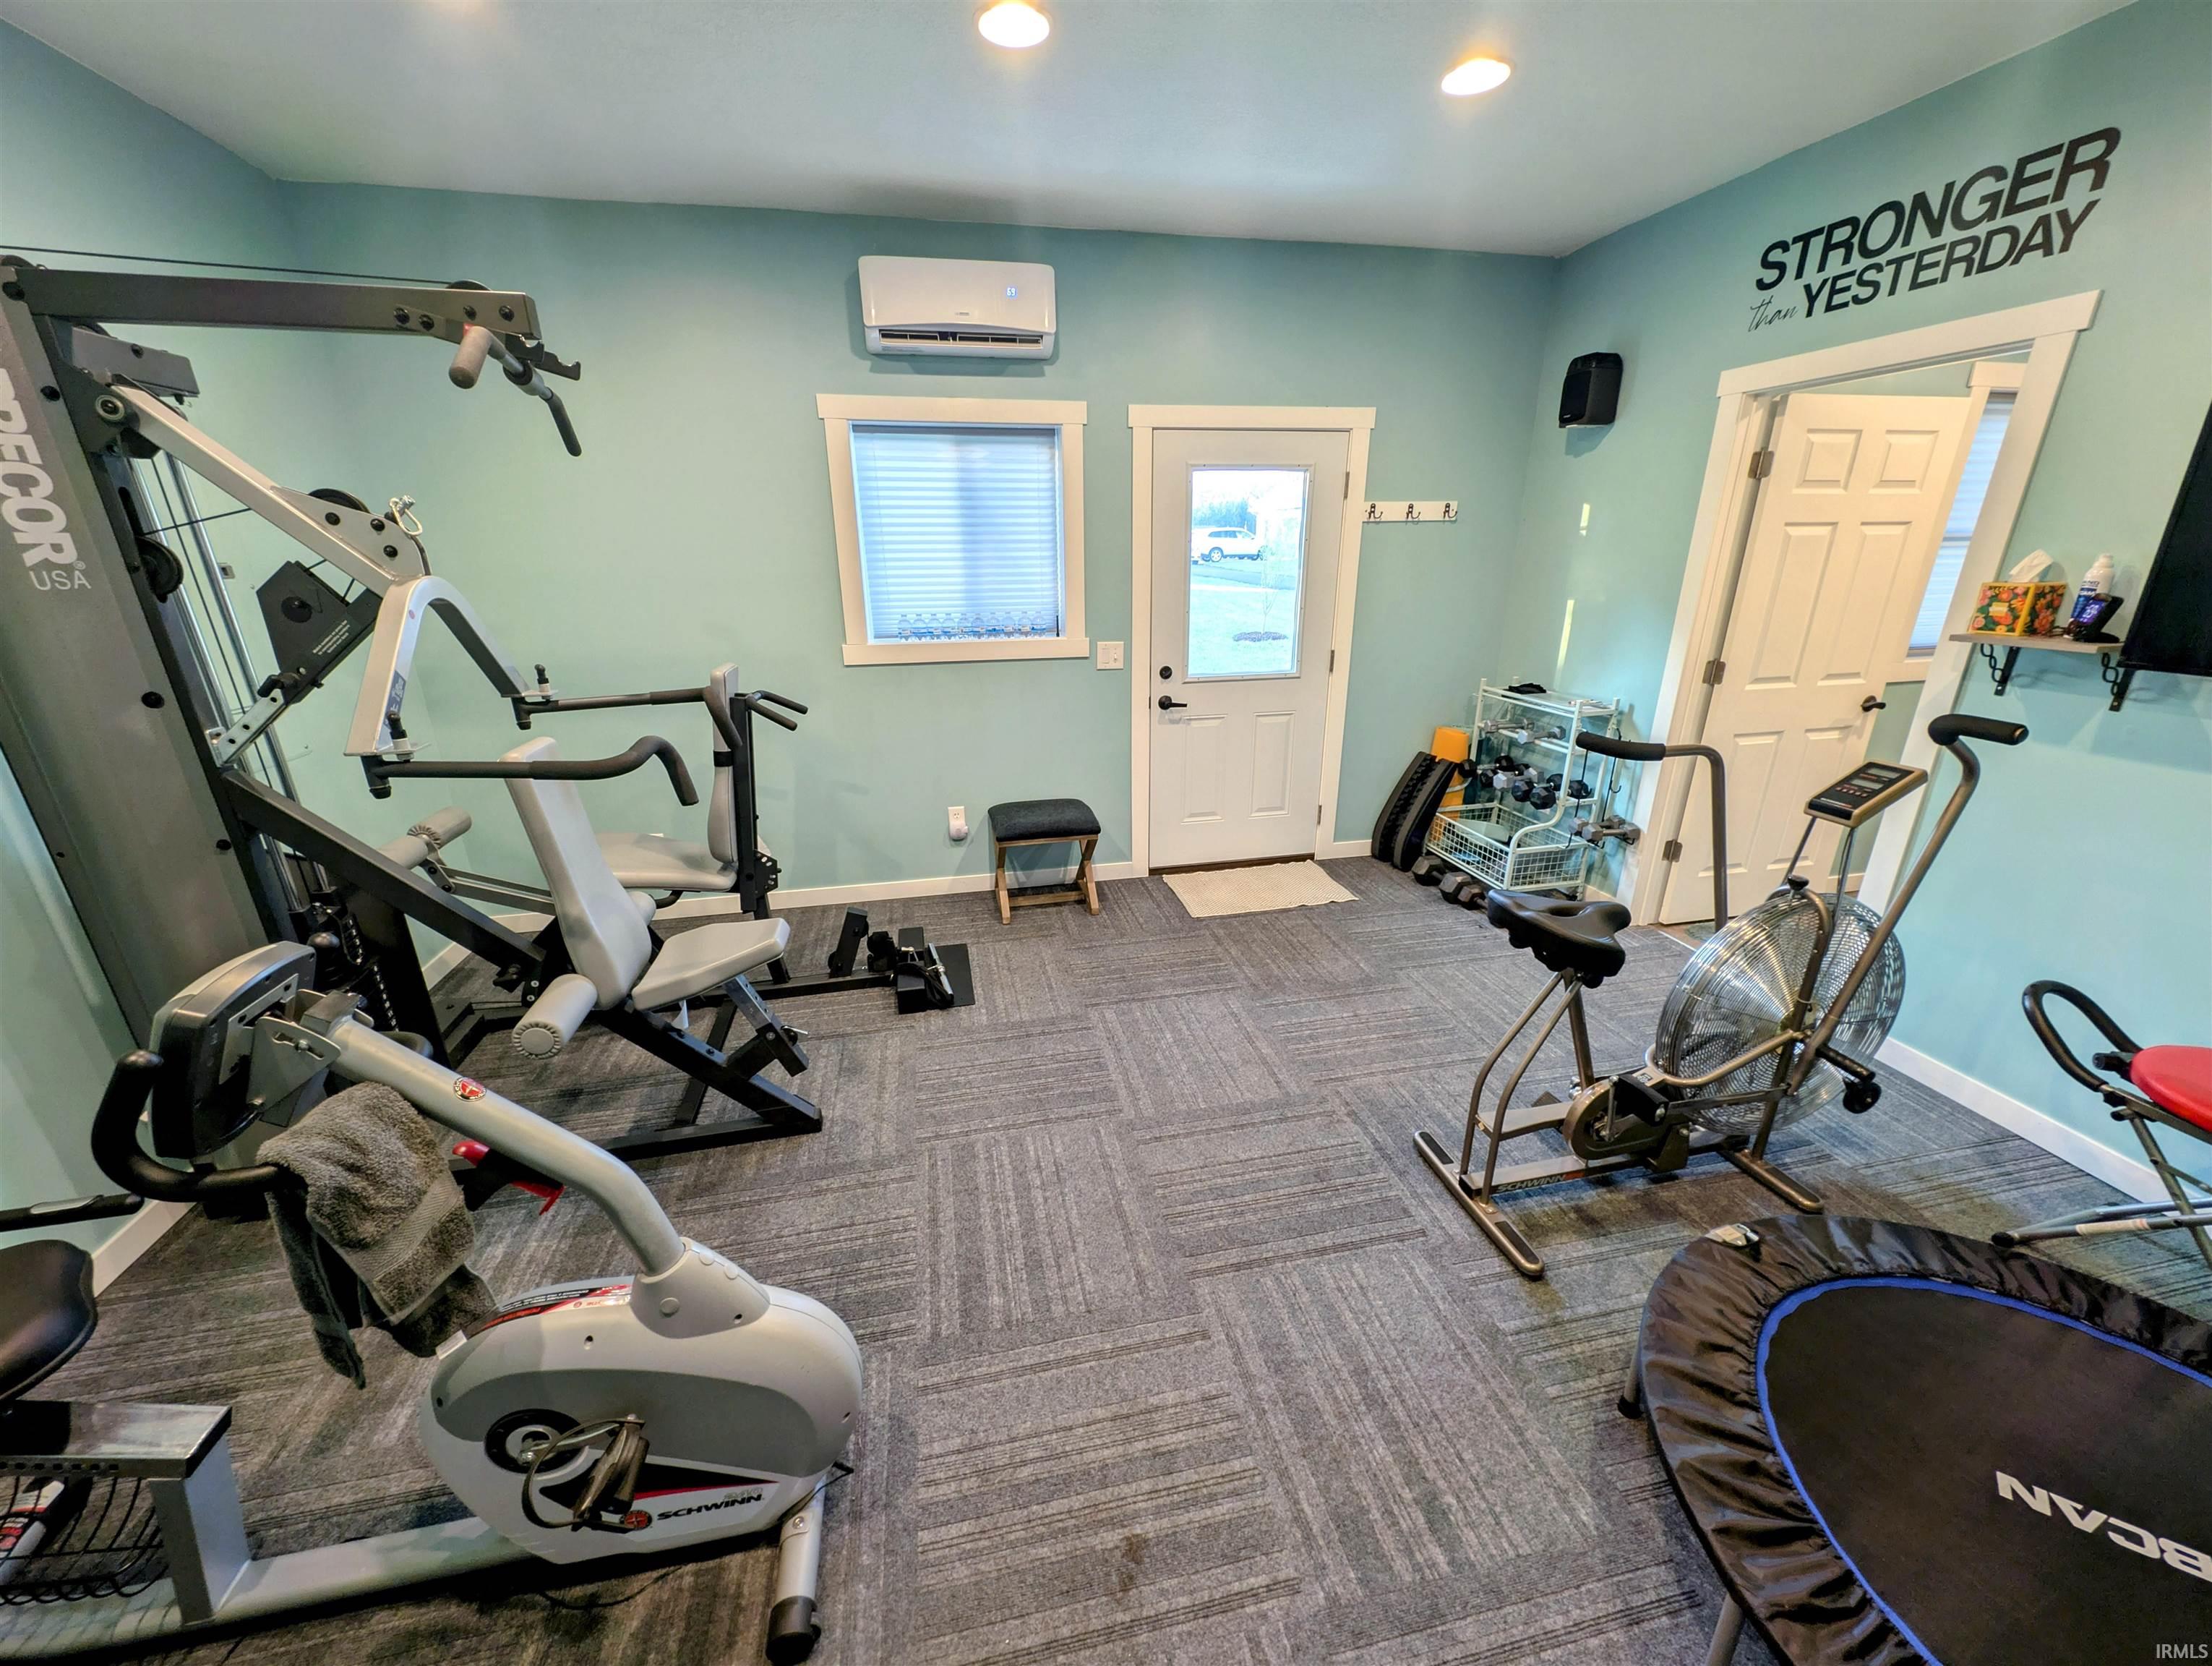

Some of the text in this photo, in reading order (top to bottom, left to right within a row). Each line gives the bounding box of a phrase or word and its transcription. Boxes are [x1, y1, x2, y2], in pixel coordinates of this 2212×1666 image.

[1756, 127, 2121, 291] STRONGER
[1748, 199, 2101, 333] than YESTERDAY
[0, 368, 78, 568] ECOR
[30, 571, 92, 591] USA
[1496, 1174, 1566, 1193] SCHWINN
[657, 1494, 762, 1521] SCHWINN
[1996, 1471, 2212, 1583] BCAN
